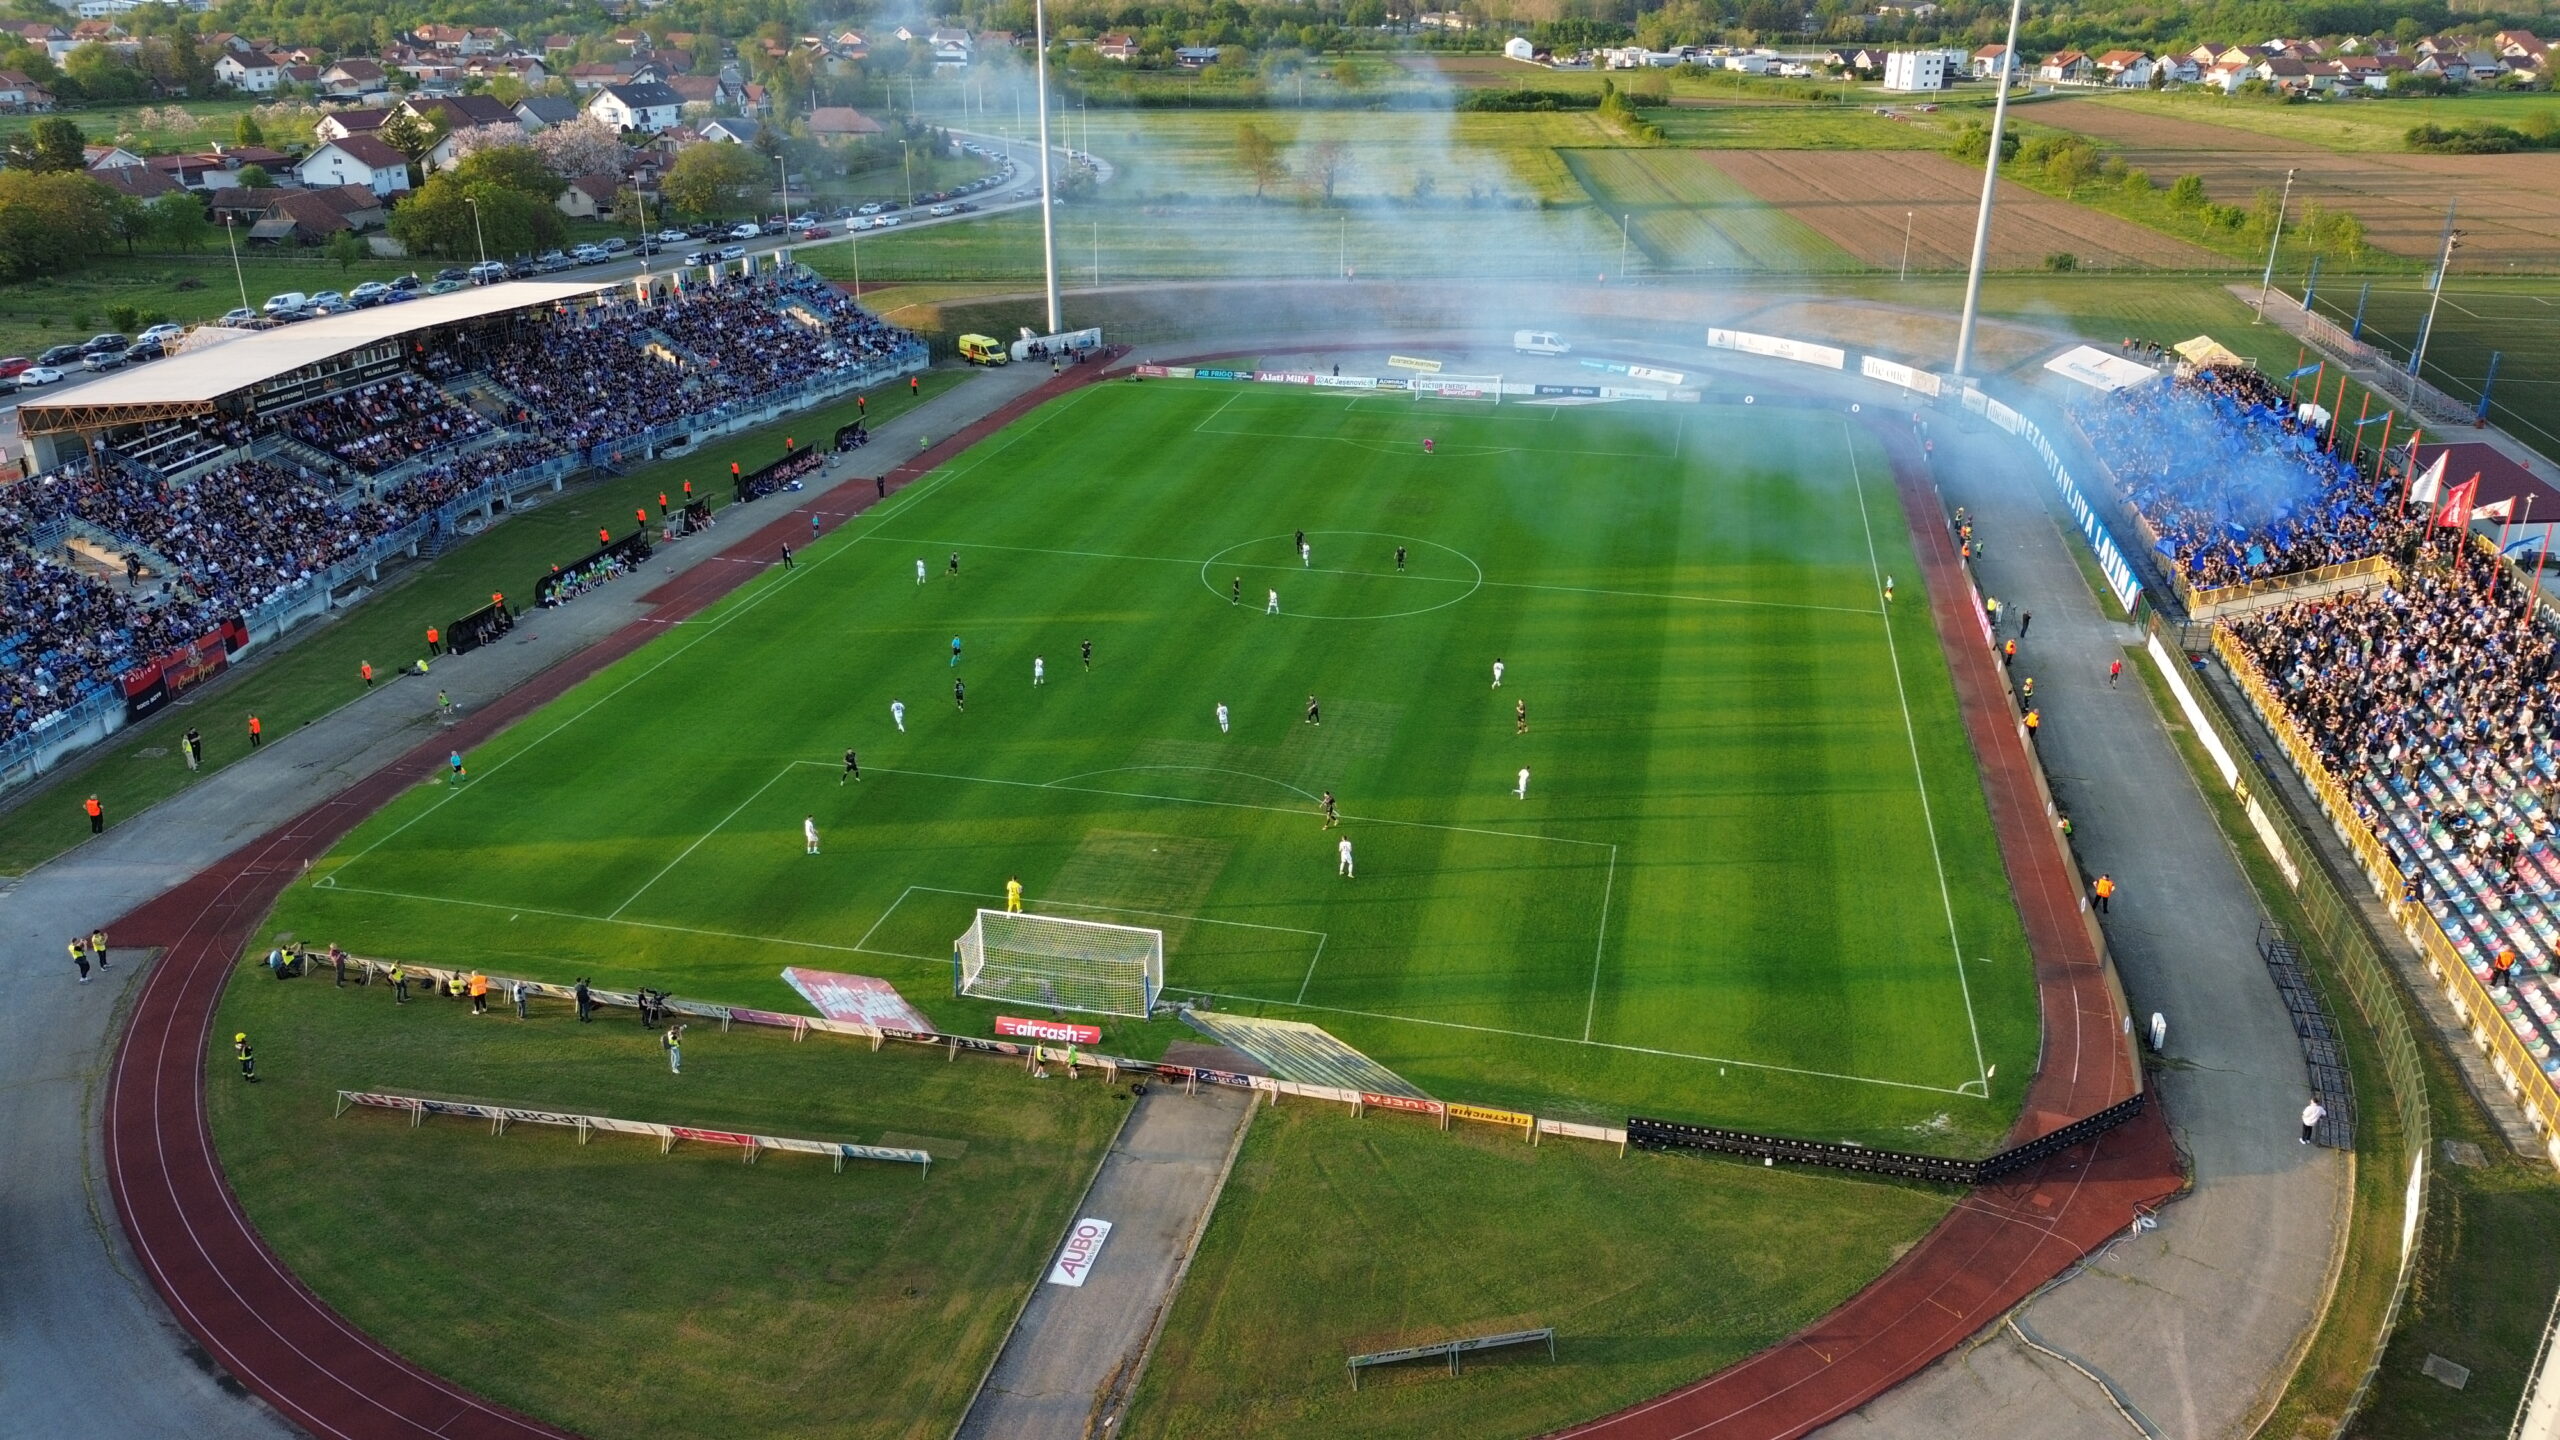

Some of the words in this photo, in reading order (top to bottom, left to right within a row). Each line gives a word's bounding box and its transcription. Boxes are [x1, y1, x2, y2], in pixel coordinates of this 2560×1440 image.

[1210, 370, 1233, 378] FRIGO
[1324, 377, 1334, 385] AC
[2016, 413, 2094, 539] NEZAUSTAVLJIVA
[2094, 525, 2138, 612] LAVINA
[1016, 1020, 1078, 1043] aircash
[1199, 1071, 1249, 1087] Zagreb
[1367, 1094, 1419, 1110] UEFA
[1060, 1225, 1099, 1279] AUBO
